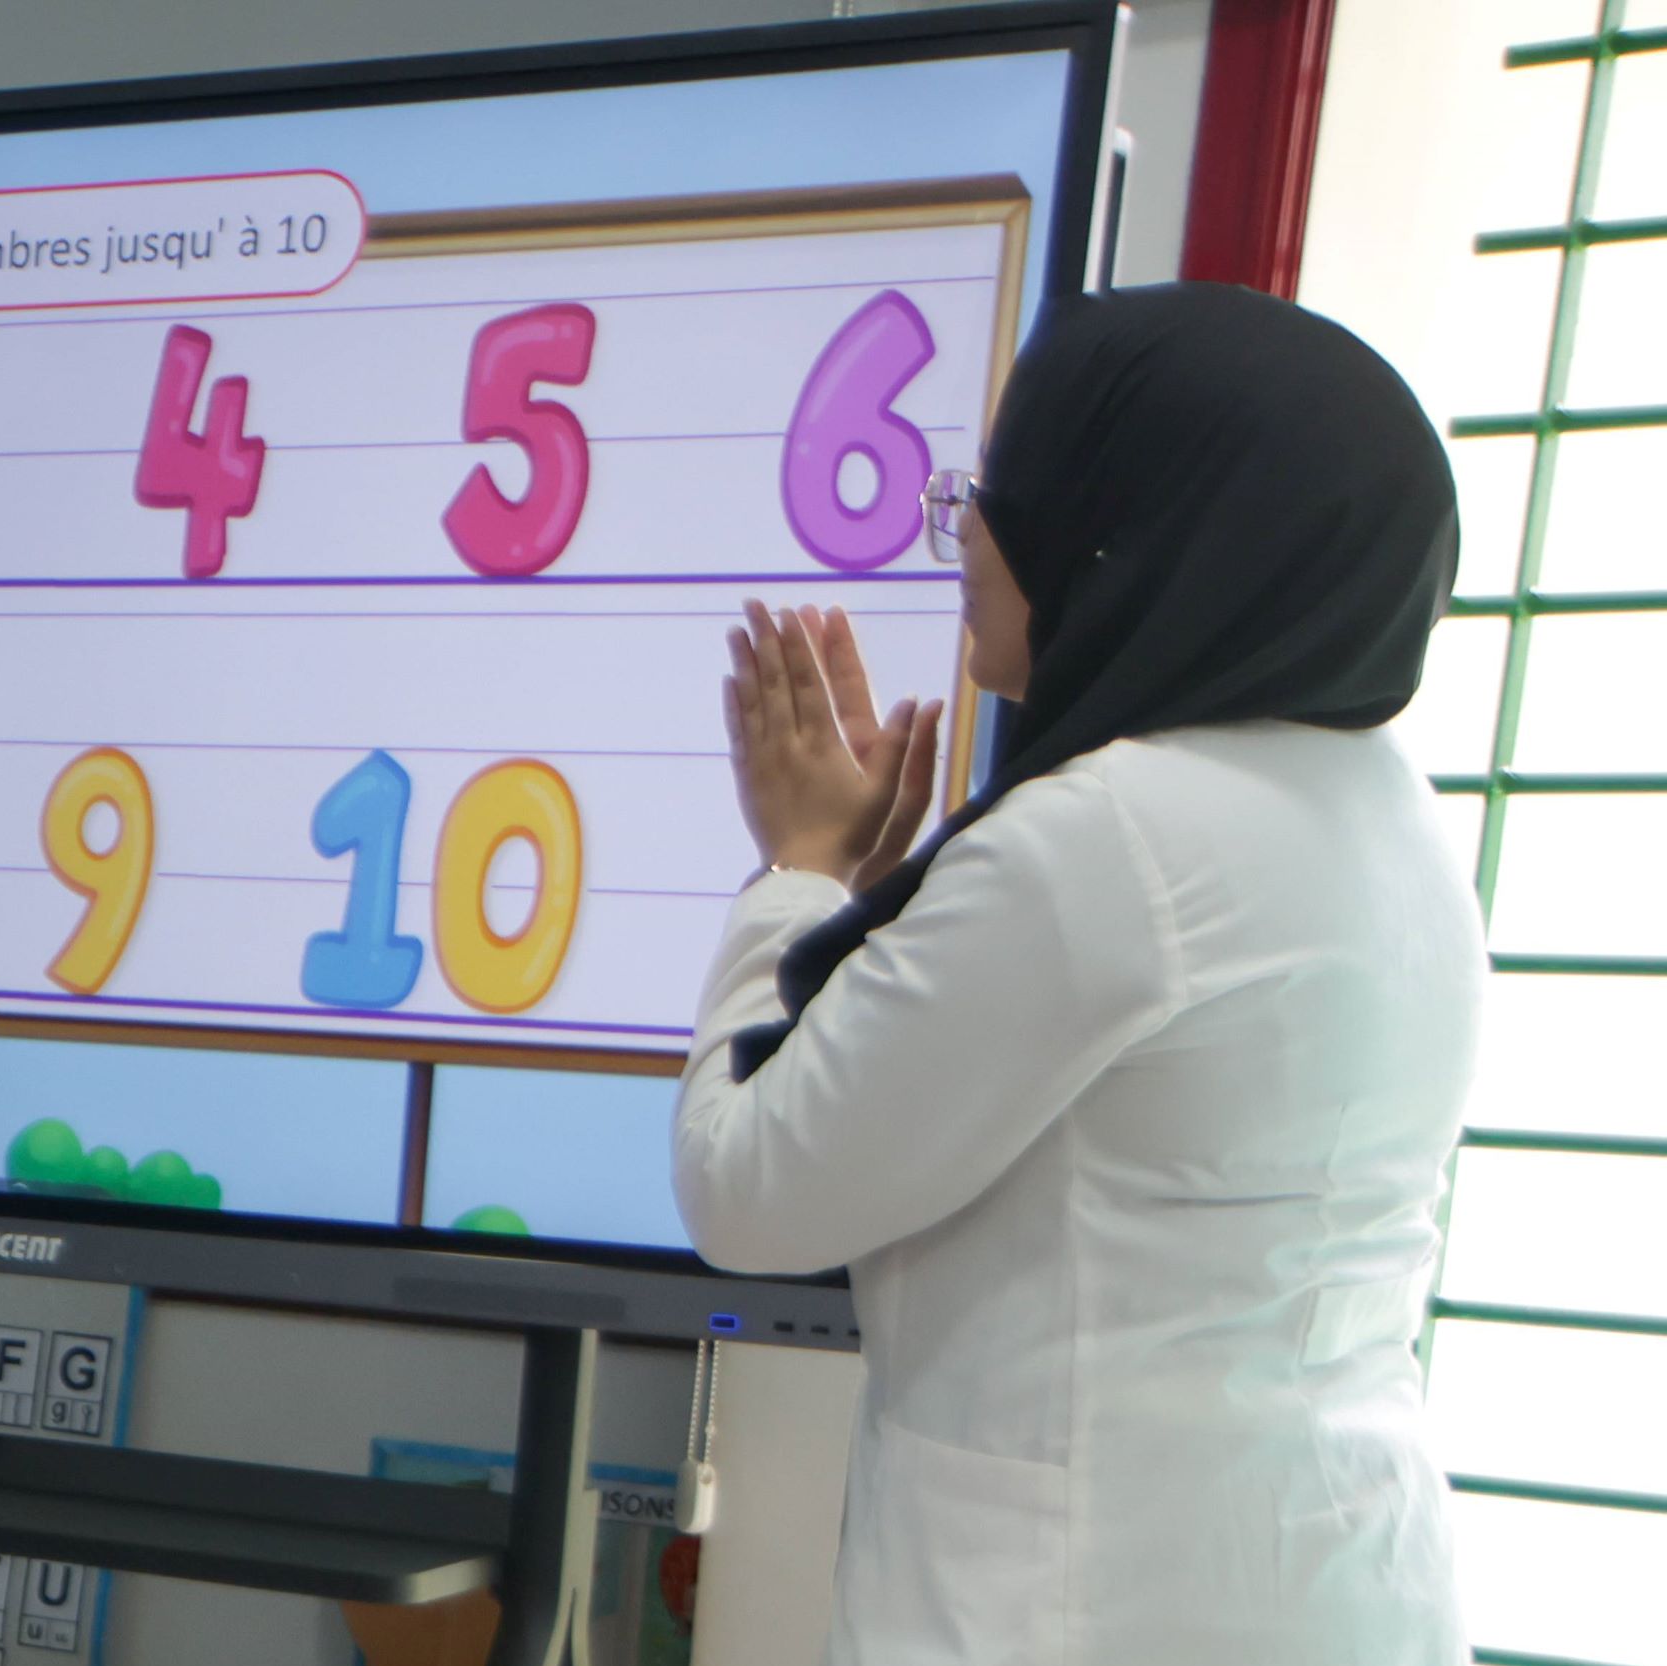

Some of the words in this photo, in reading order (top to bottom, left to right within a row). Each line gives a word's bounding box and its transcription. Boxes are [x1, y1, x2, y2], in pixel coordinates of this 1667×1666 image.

[100, 217, 227, 274] jusqu'
[238, 214, 261, 256] à
[275, 213, 328, 256] 10
[133, 323, 266, 579] 4
[441, 302, 596, 578] 5
[780, 288, 935, 573] 6
[39, 745, 156, 998] 9
[299, 748, 586, 1015] 10
[59, 1346, 97, 1391] G
[37, 1561, 72, 1607] U
